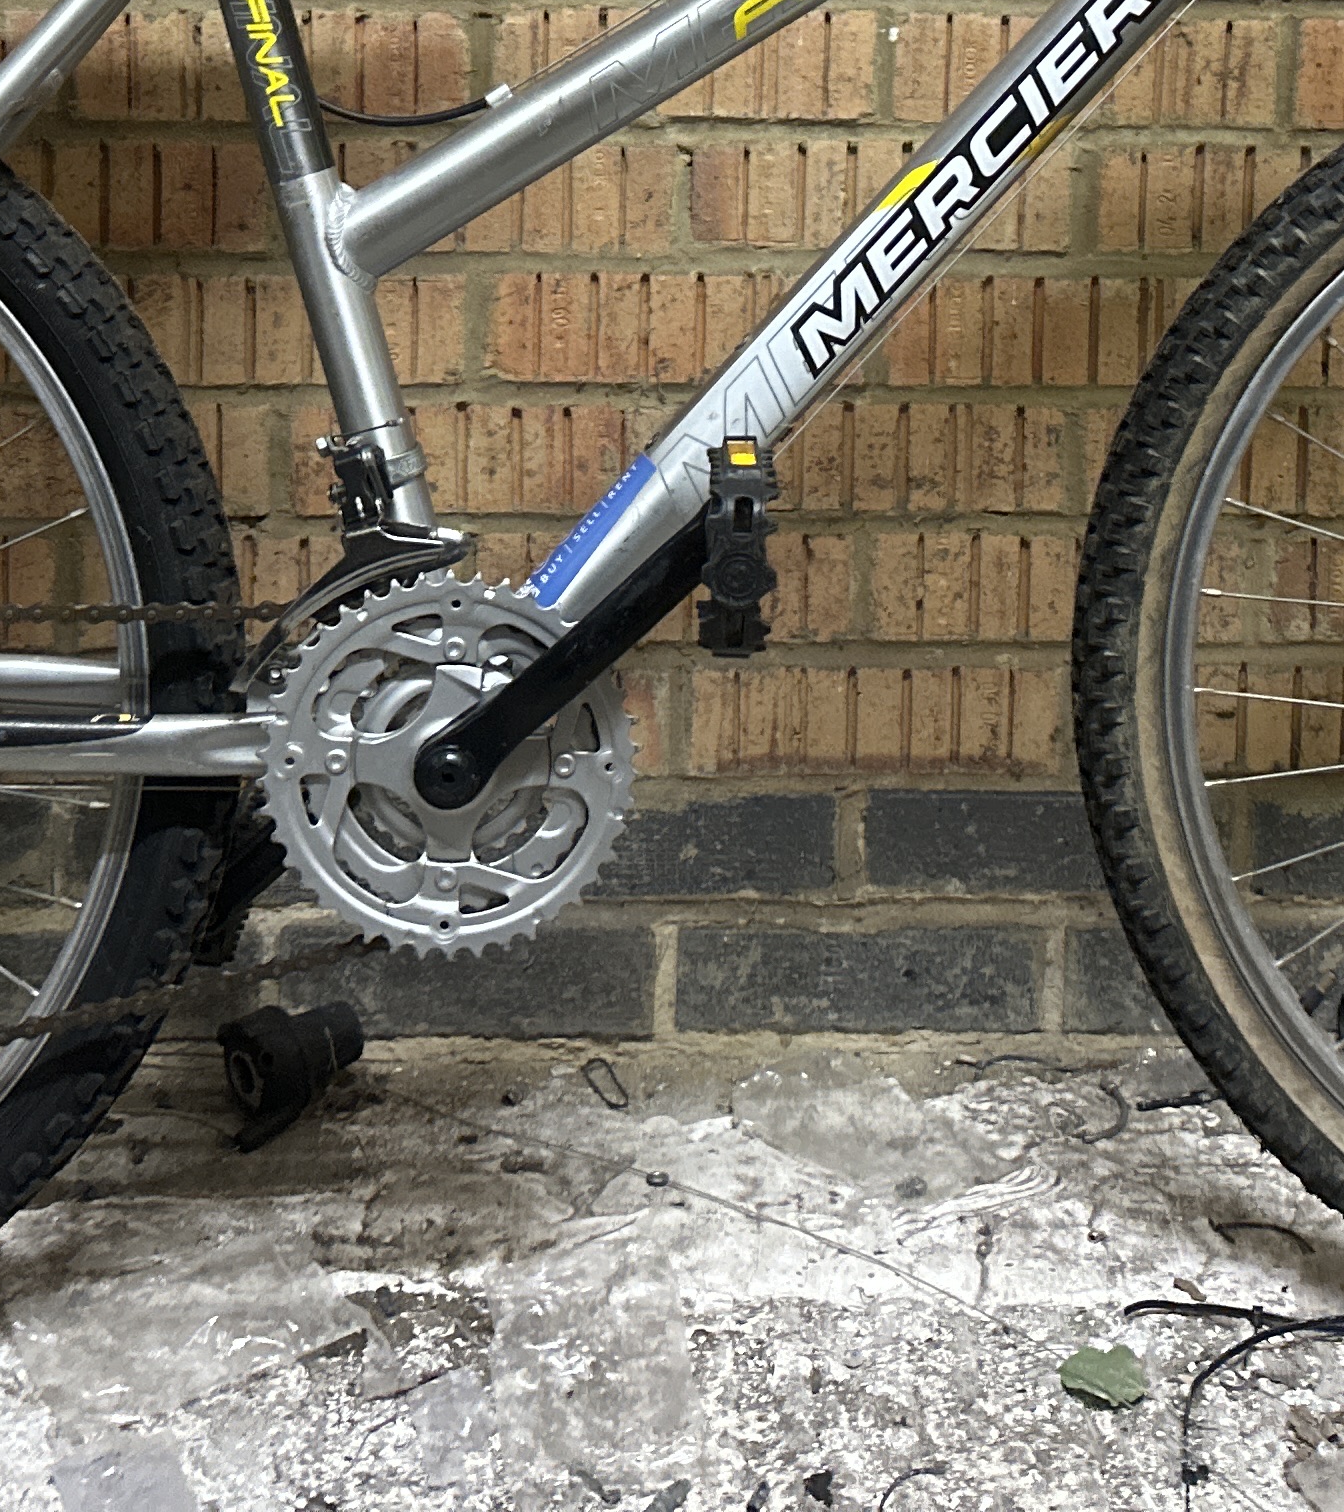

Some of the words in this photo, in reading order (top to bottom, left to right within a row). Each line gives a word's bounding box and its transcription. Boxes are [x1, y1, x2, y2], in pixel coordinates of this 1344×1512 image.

[540, 554, 563, 584] BUY
[572, 510, 601, 543] SELL
[606, 463, 638, 500] RENT
